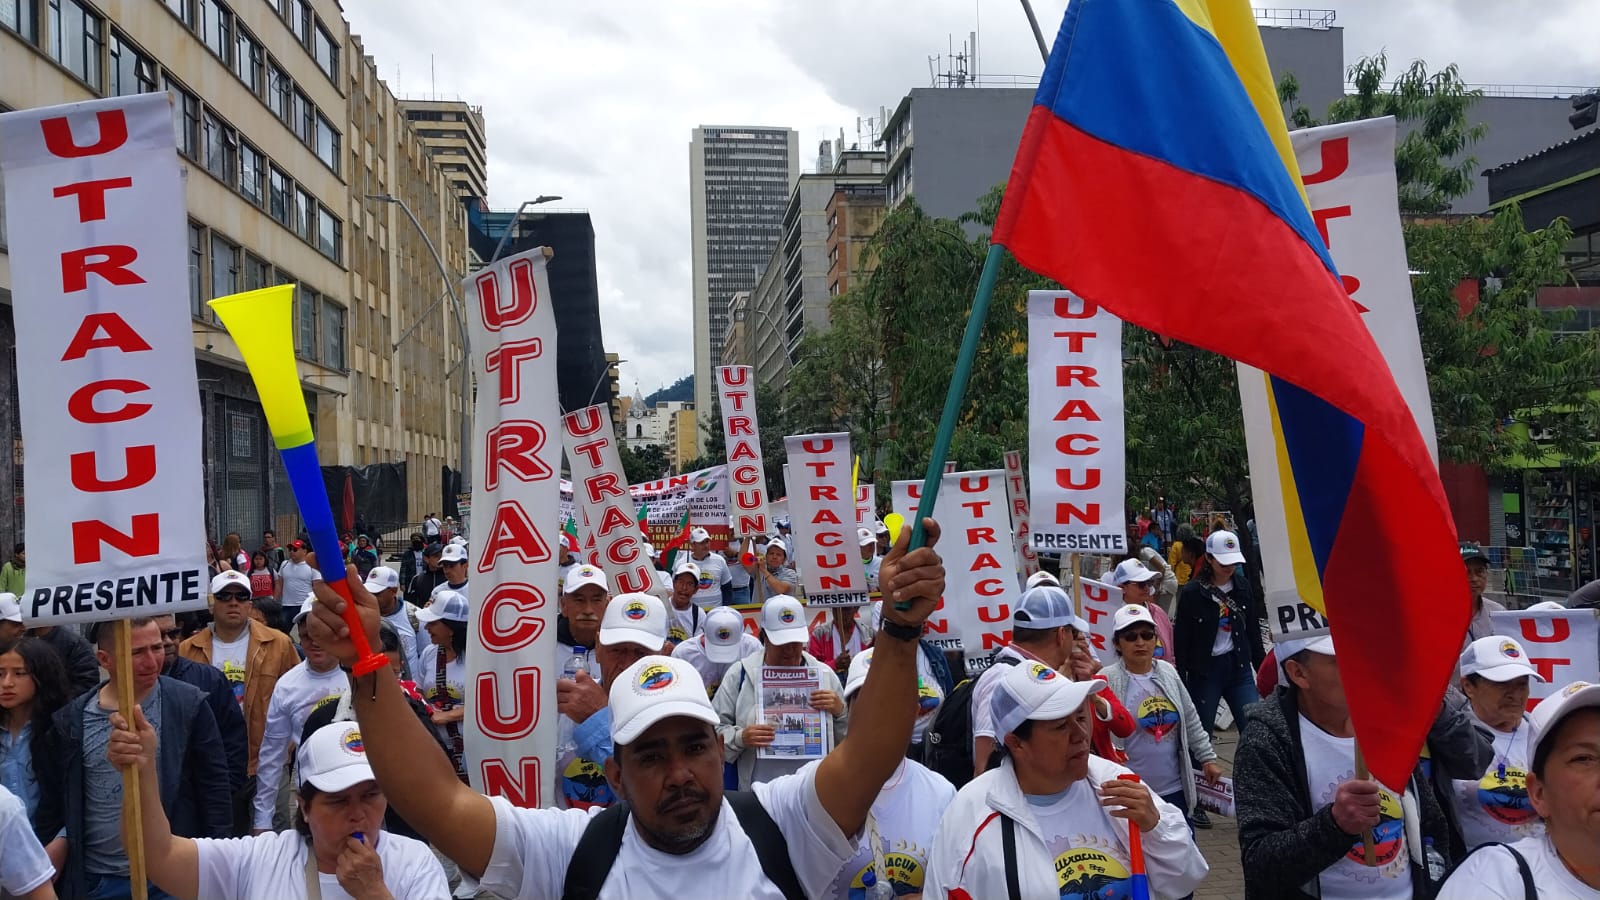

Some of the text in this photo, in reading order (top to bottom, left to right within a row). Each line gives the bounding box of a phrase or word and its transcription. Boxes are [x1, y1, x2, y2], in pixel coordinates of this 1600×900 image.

[40, 109, 160, 565] UTRACUN
[1052, 297, 1102, 525] UTRACUN
[564, 405, 666, 597] UTRACU
[722, 366, 767, 536] UTRACUN
[802, 438, 851, 590] UTRACUN
[31, 569, 200, 618] PRESENTE
[474, 257, 553, 809] UTRACUN
[809, 592, 867, 605] PRESENTE
[959, 476, 1013, 650] UTRACUN
[1033, 532, 1124, 550] PRESENTE
[763, 670, 806, 679] Utracun
[1054, 853, 1108, 873] Utracun
